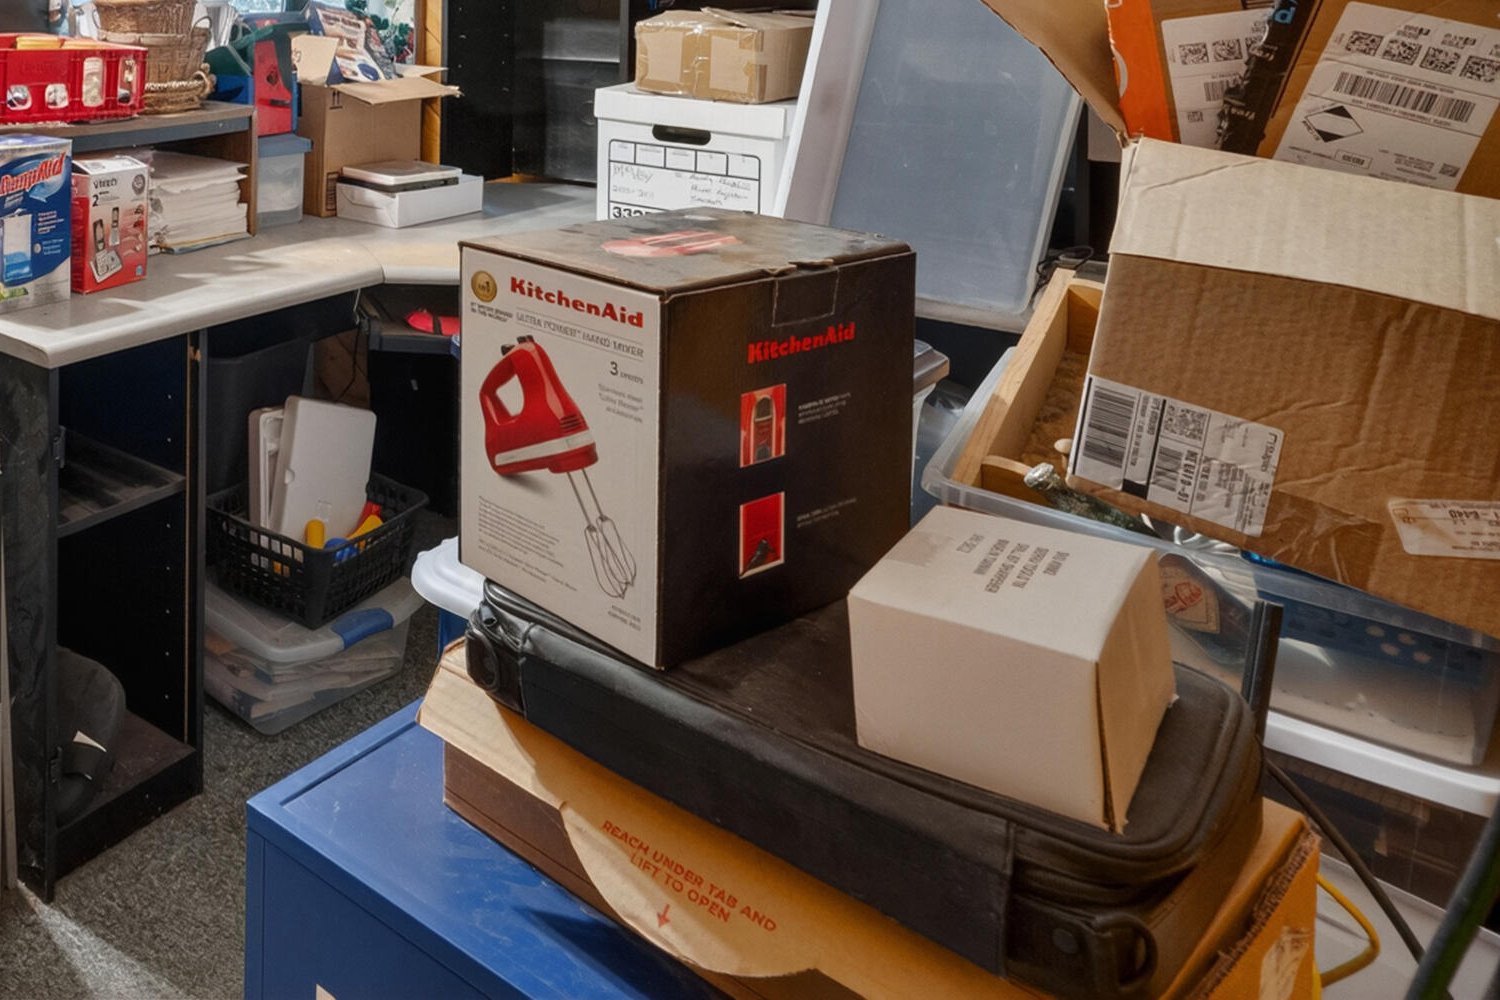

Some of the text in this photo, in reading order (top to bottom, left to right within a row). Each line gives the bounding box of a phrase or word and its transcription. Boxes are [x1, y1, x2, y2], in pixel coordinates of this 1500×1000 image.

[510, 276, 644, 328] KitchenAid
[748, 321, 856, 364] KitchenAid
[609, 361, 619, 377] 3
[602, 820, 777, 932] REACH UNDER TAB AND
[630, 853, 731, 923] LIFT TO OPEN
